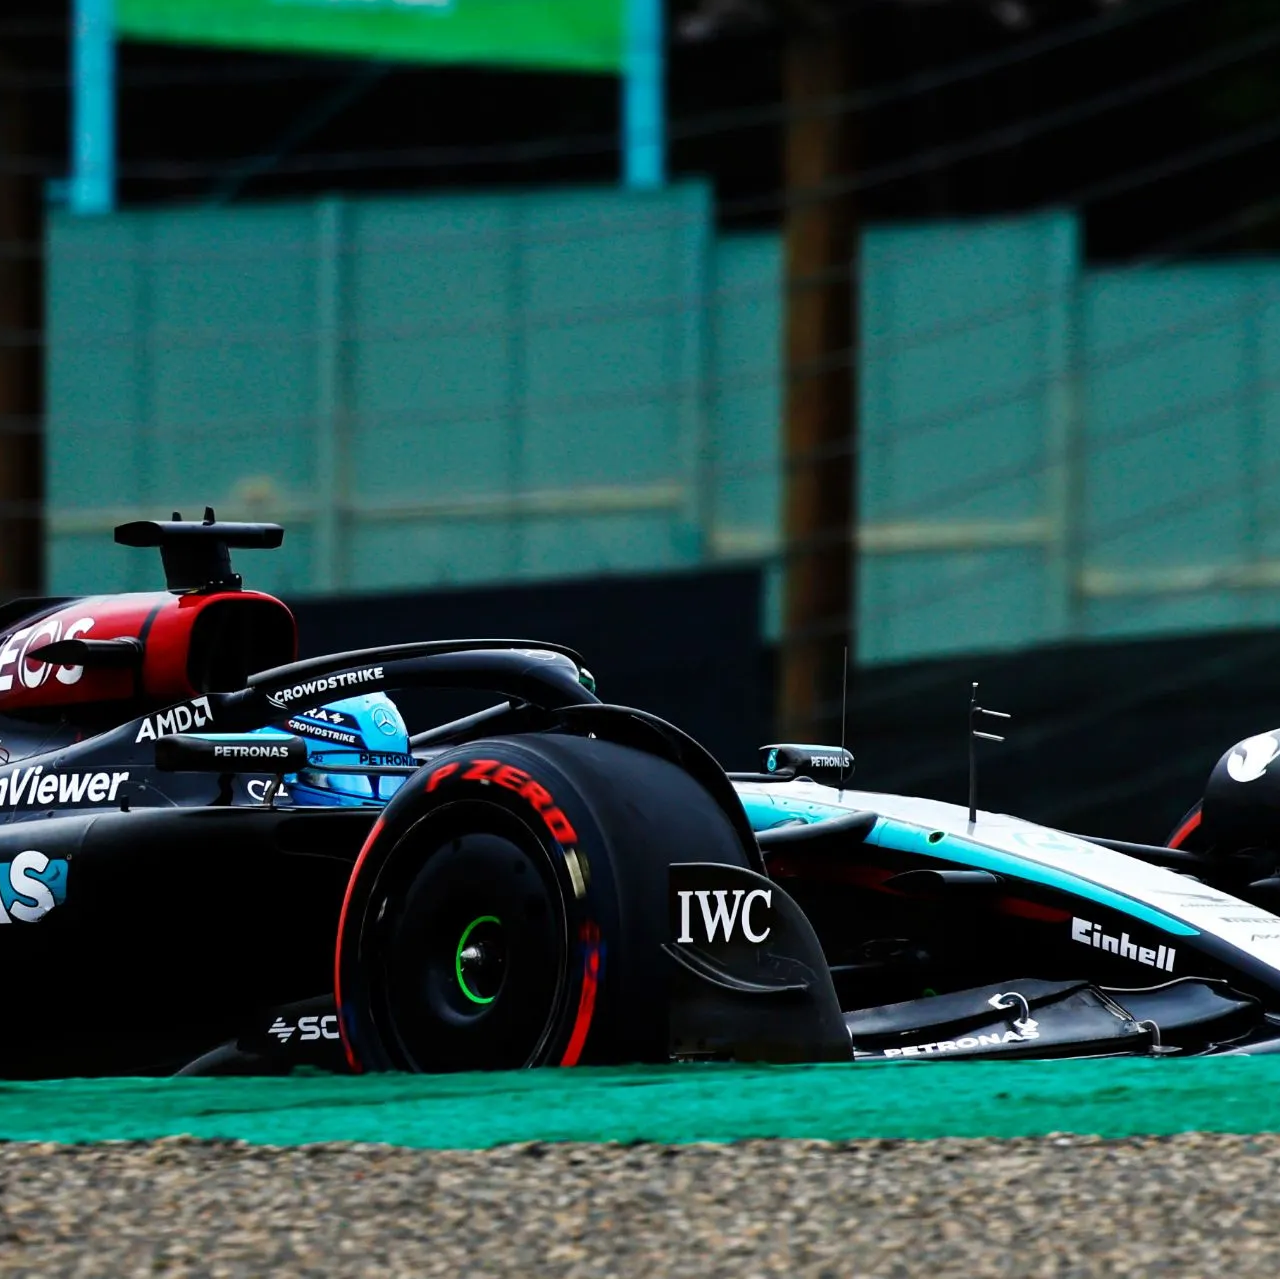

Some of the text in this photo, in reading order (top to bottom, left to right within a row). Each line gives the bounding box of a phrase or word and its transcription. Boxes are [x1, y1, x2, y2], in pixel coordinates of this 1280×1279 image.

[274, 667, 384, 704] CROWDSTRIKE
[135, 706, 193, 743] AMD
[288, 720, 356, 743] CROWDSTRIKE
[214, 746, 289, 758] PETRONAS
[810, 755, 850, 768] PETRONAS
[461, 758, 578, 844] ZERO
[677, 888, 773, 945] IWC
[1071, 916, 1176, 973] Einhell
[883, 1028, 1040, 1058] PETRONAS
